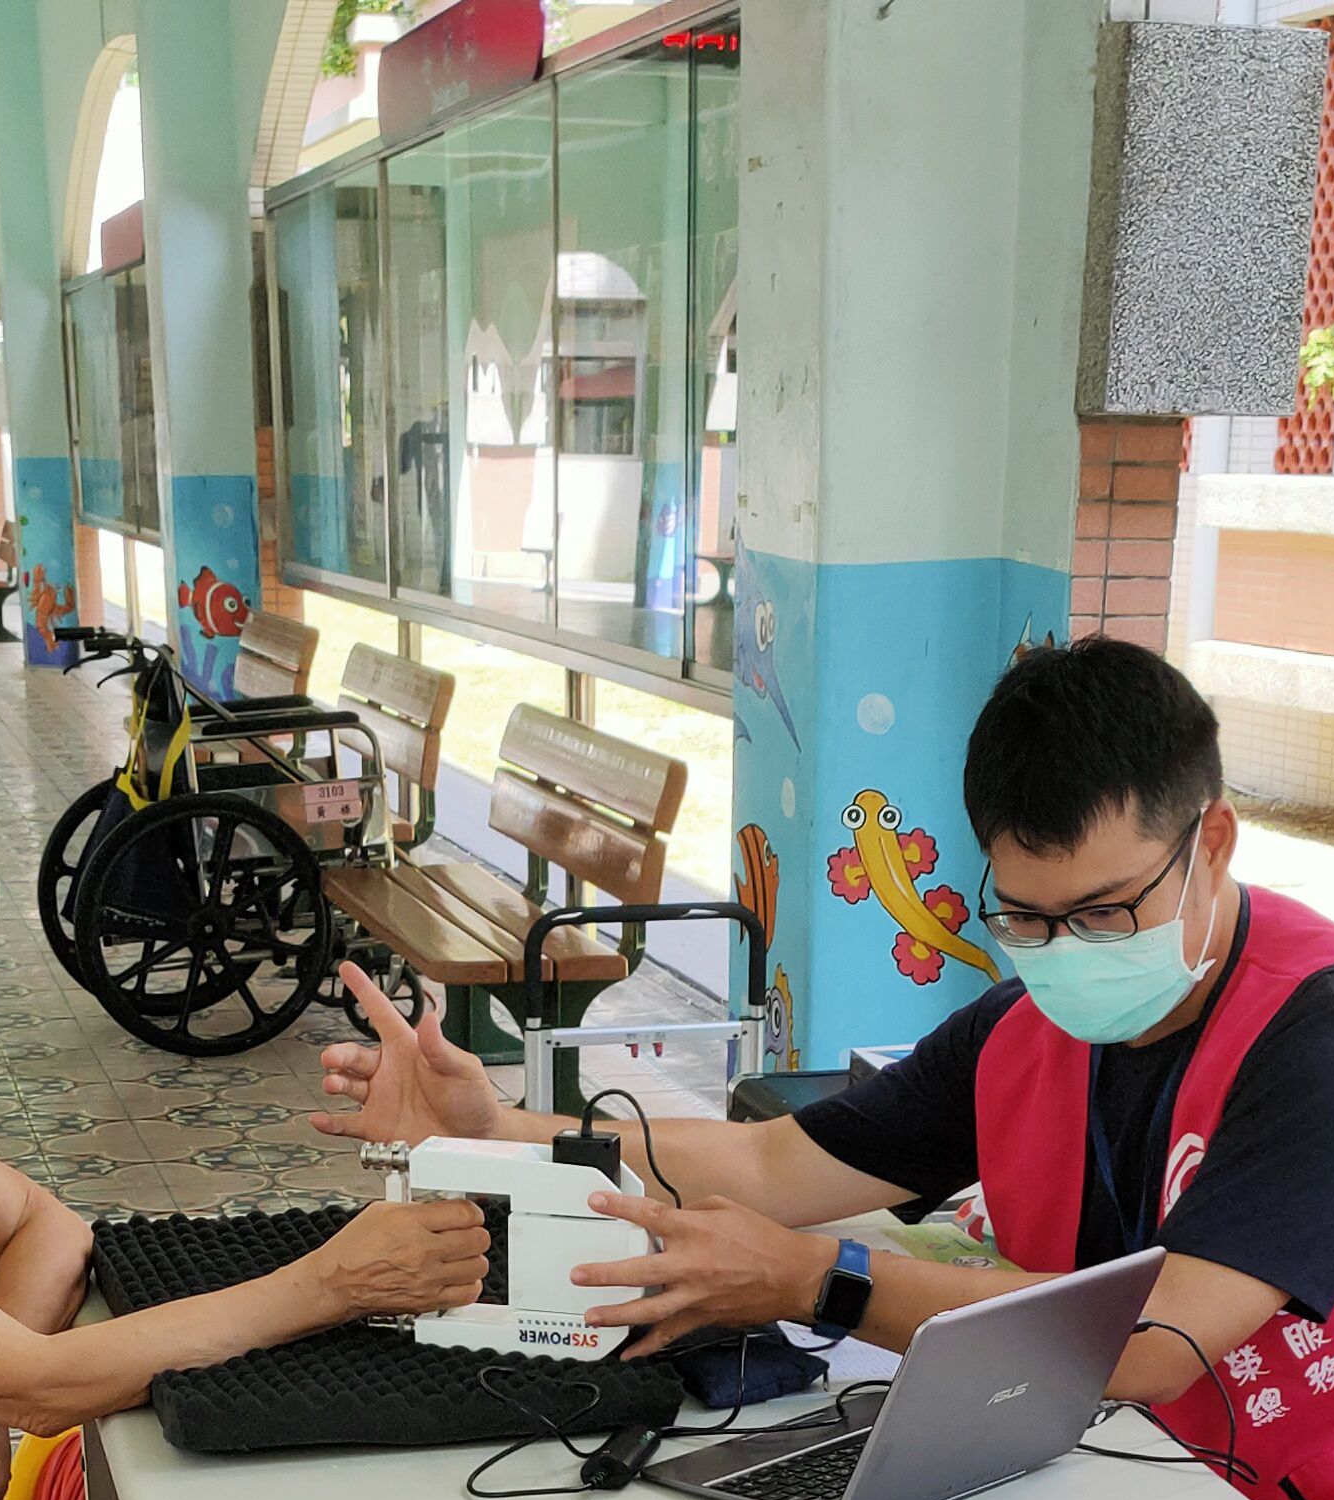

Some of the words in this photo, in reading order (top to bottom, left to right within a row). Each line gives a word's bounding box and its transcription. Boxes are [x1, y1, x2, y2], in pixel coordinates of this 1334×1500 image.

[318, 785, 344, 798] 3103
[518, 1329, 599, 1348] SYSPOWER
[986, 1382, 1029, 1406] ASUS
